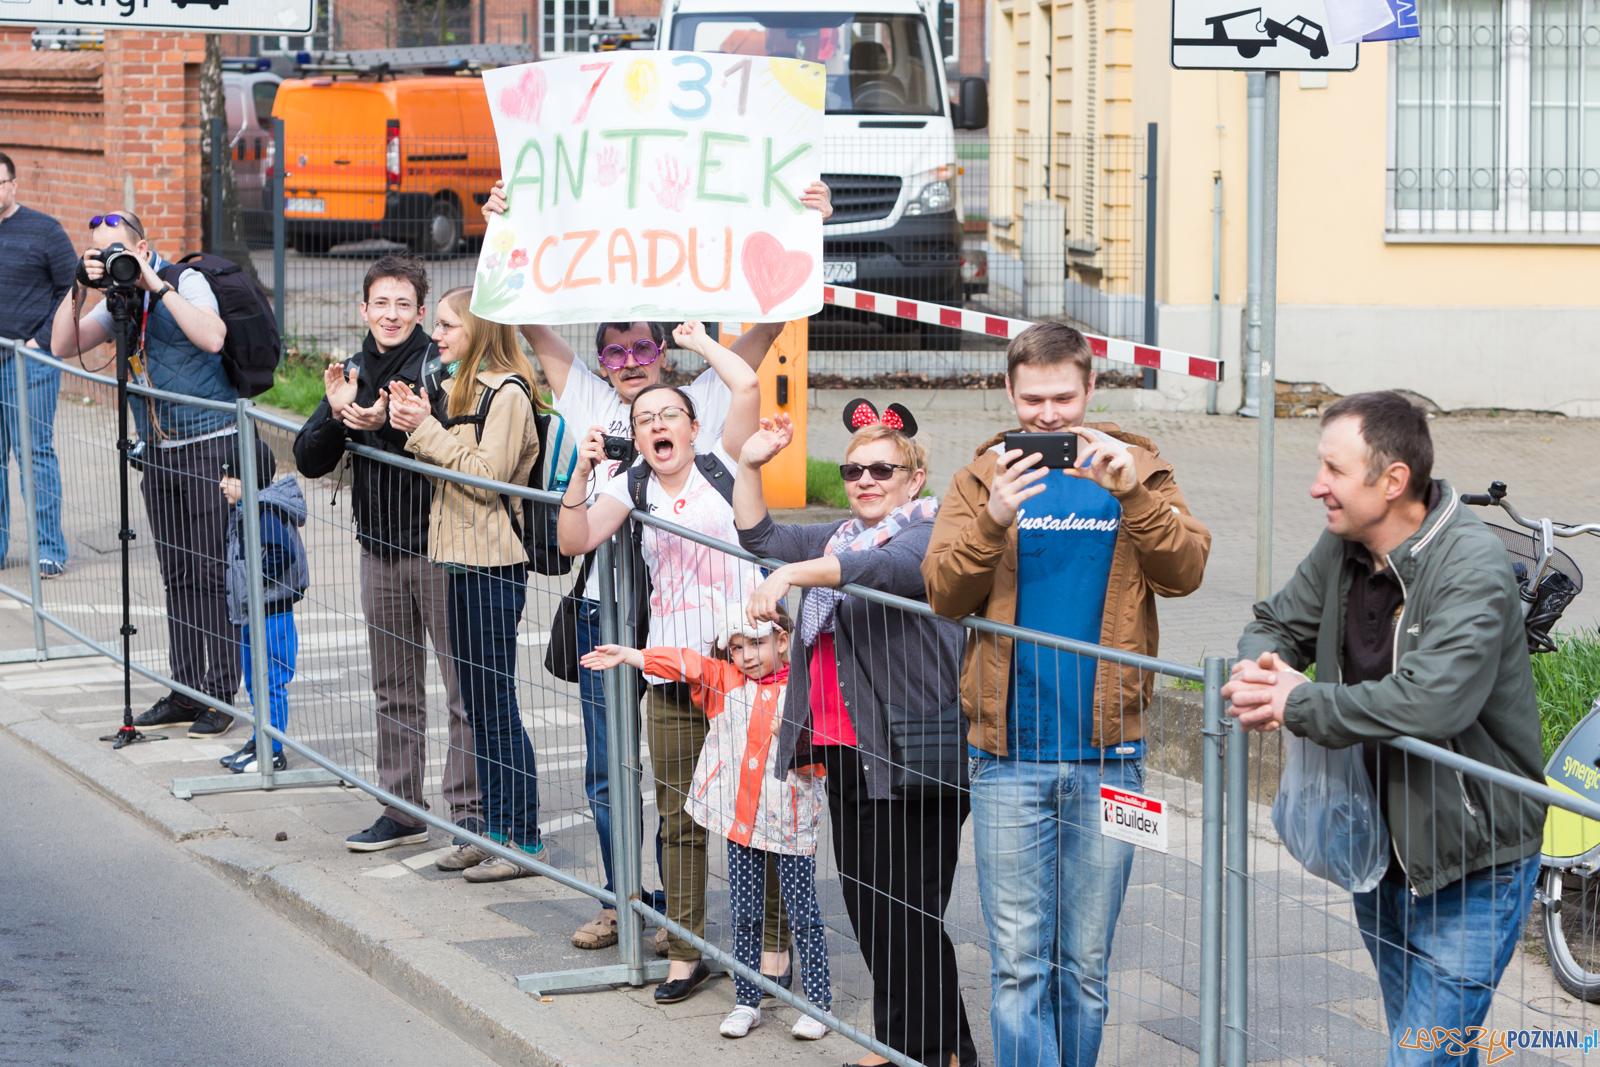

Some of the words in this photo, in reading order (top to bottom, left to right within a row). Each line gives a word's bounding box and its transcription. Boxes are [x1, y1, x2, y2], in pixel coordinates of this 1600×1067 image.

[500, 128, 814, 219] ANTEK
[532, 226, 733, 294] CZADU
[1116, 806, 1159, 836] Buildex
